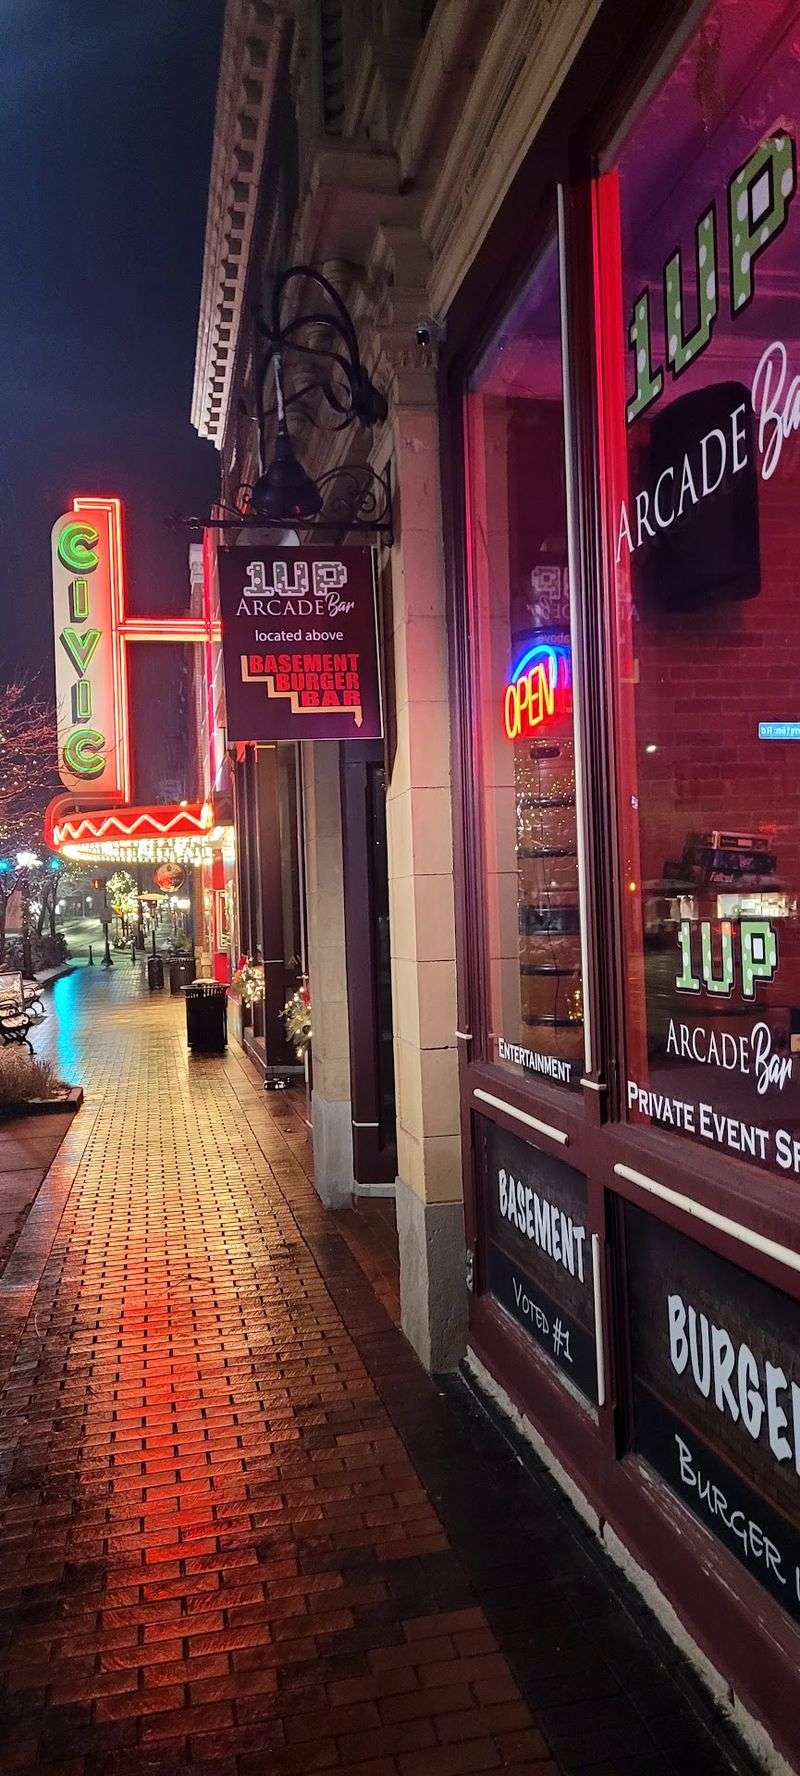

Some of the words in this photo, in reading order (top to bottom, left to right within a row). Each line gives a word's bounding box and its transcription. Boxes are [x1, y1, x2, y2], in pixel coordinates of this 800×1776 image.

[626, 128, 796, 430] 1UP
[615, 403, 748, 563] ARCADE
[236, 598, 325, 616] ARCADE
[325, 592, 355, 617] Bar
[243, 561, 348, 597] 1UP
[58, 523, 107, 780] CIVIC
[250, 654, 360, 673] BASEMENT
[255, 629, 302, 642] located
[306, 629, 344, 642] above
[276, 672, 360, 691] BURGER
[301, 690, 361, 706] BAR
[505, 662, 555, 739] OPEN
[675, 917, 780, 1001] 1UP
[498, 1038, 572, 1083] ENTERTAINMENT
[666, 1018, 750, 1074] ARCADE
[751, 1021, 793, 1095] Bar
[627, 1081, 696, 1133] PRIVATE
[699, 1103, 769, 1160] EVENT
[498, 1168, 585, 1284] BASEMENT
[512, 1277, 549, 1336] VOTED
[552, 1317, 574, 1363] #1
[674, 1433, 787, 1585] BURGER
